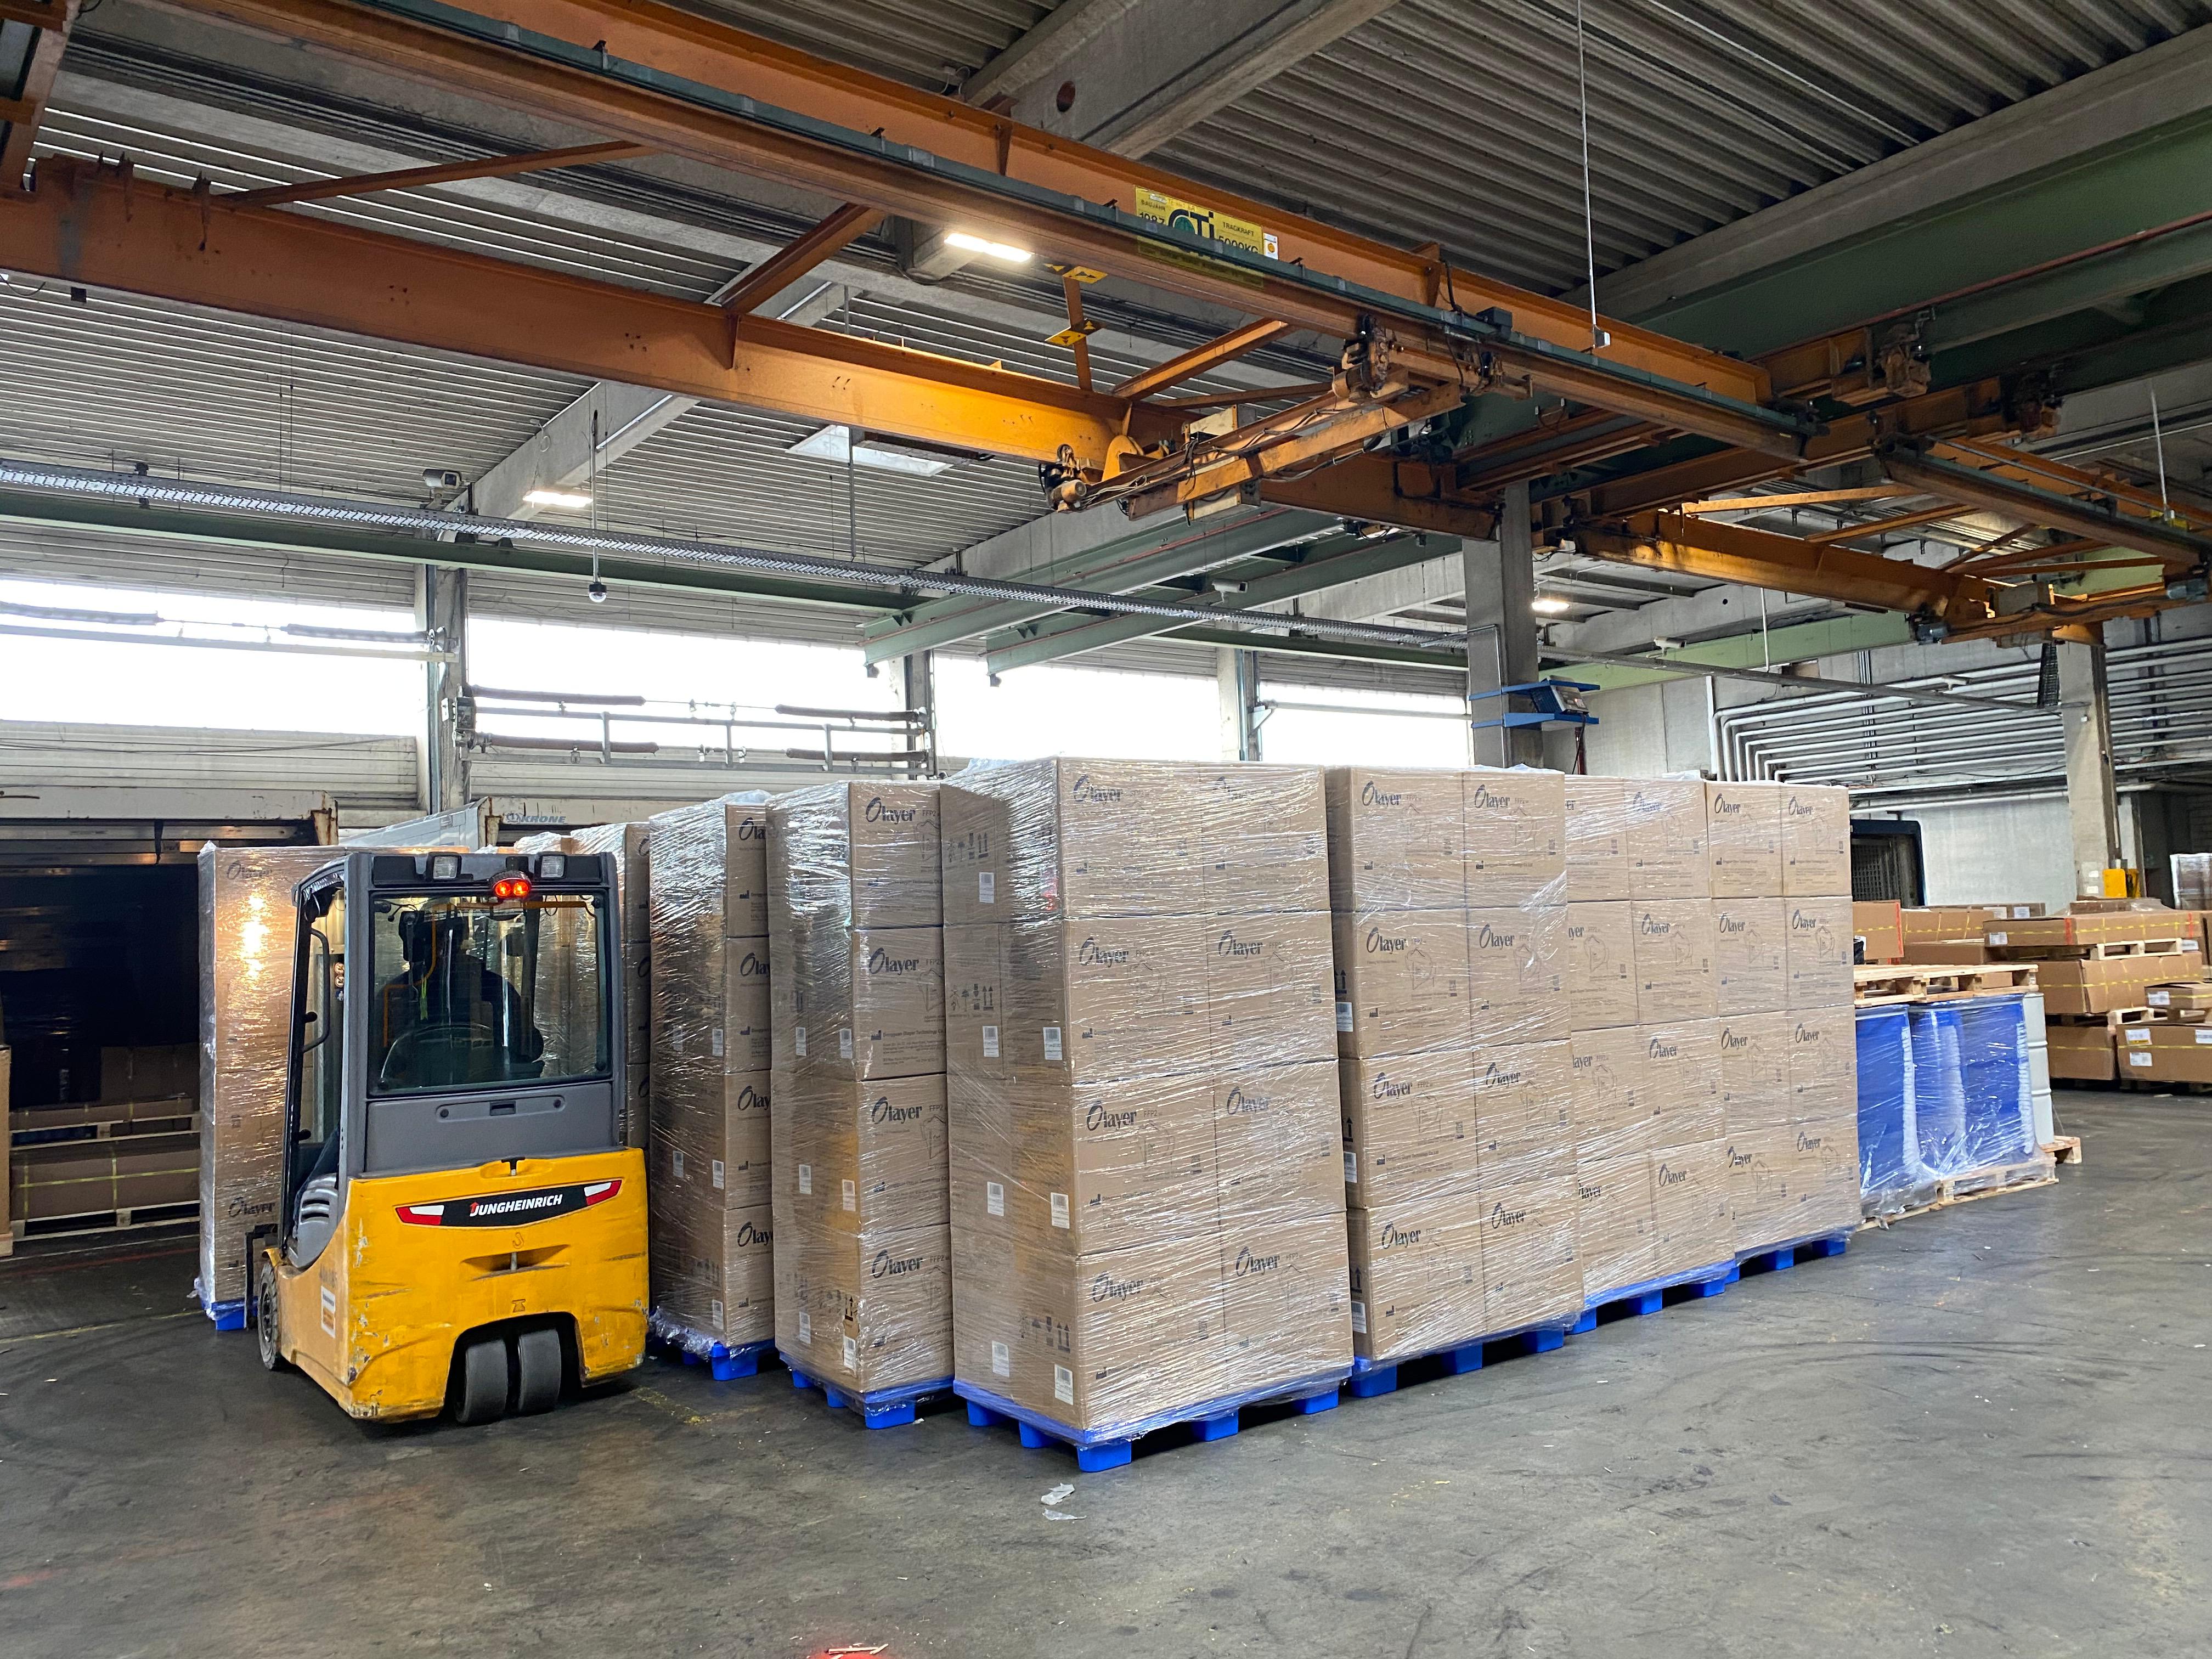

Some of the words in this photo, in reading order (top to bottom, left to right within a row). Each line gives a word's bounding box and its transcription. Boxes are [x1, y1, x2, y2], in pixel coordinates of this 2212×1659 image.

[1222, 221, 1254, 236] TRAGKRAFT
[1362, 781, 1402, 808] Olayer
[1474, 784, 1510, 810] Olayer
[1714, 793, 1741, 815] Olayer
[1788, 796, 1813, 817] Olayer
[866, 797, 916, 823] Olayer
[1641, 914, 1670, 936] Olayer
[1719, 912, 1746, 935] Olayer
[1792, 909, 1816, 930] Olayer
[1218, 930, 1263, 958] Olayer
[1366, 927, 1406, 954] Olayer
[1480, 924, 1514, 949] Olayer
[869, 947, 919, 974] Olayer
[1079, 937, 1129, 968] Olayer
[1722, 1027, 1748, 1049] Olayer
[1796, 1023, 1820, 1043] Olayer
[1650, 1037, 1678, 1060] Olayer
[1373, 1072, 1413, 1099] Olayer
[1486, 1062, 1521, 1088] Olayer
[871, 1097, 922, 1124] Olayer
[929, 1104, 943, 1113] FFP2
[1227, 1087, 1271, 1115] Olayer
[1087, 1101, 1137, 1132] Olayer
[1797, 1131, 1821, 1152] Olayer
[1728, 1146, 1753, 1167] Olayer
[1659, 1163, 1687, 1187] Olayer
[1577, 1178, 1602, 1201] layer
[470, 1194, 563, 1217] JUNGHEINRICH
[1492, 1203, 1526, 1229] Olayer
[1381, 1222, 1421, 1249] Olayer
[872, 1250, 923, 1278] Olayer
[930, 1254, 944, 1263] FFP2
[1235, 1246, 1280, 1277] Olayer
[1092, 1271, 1143, 1303] Olayer
